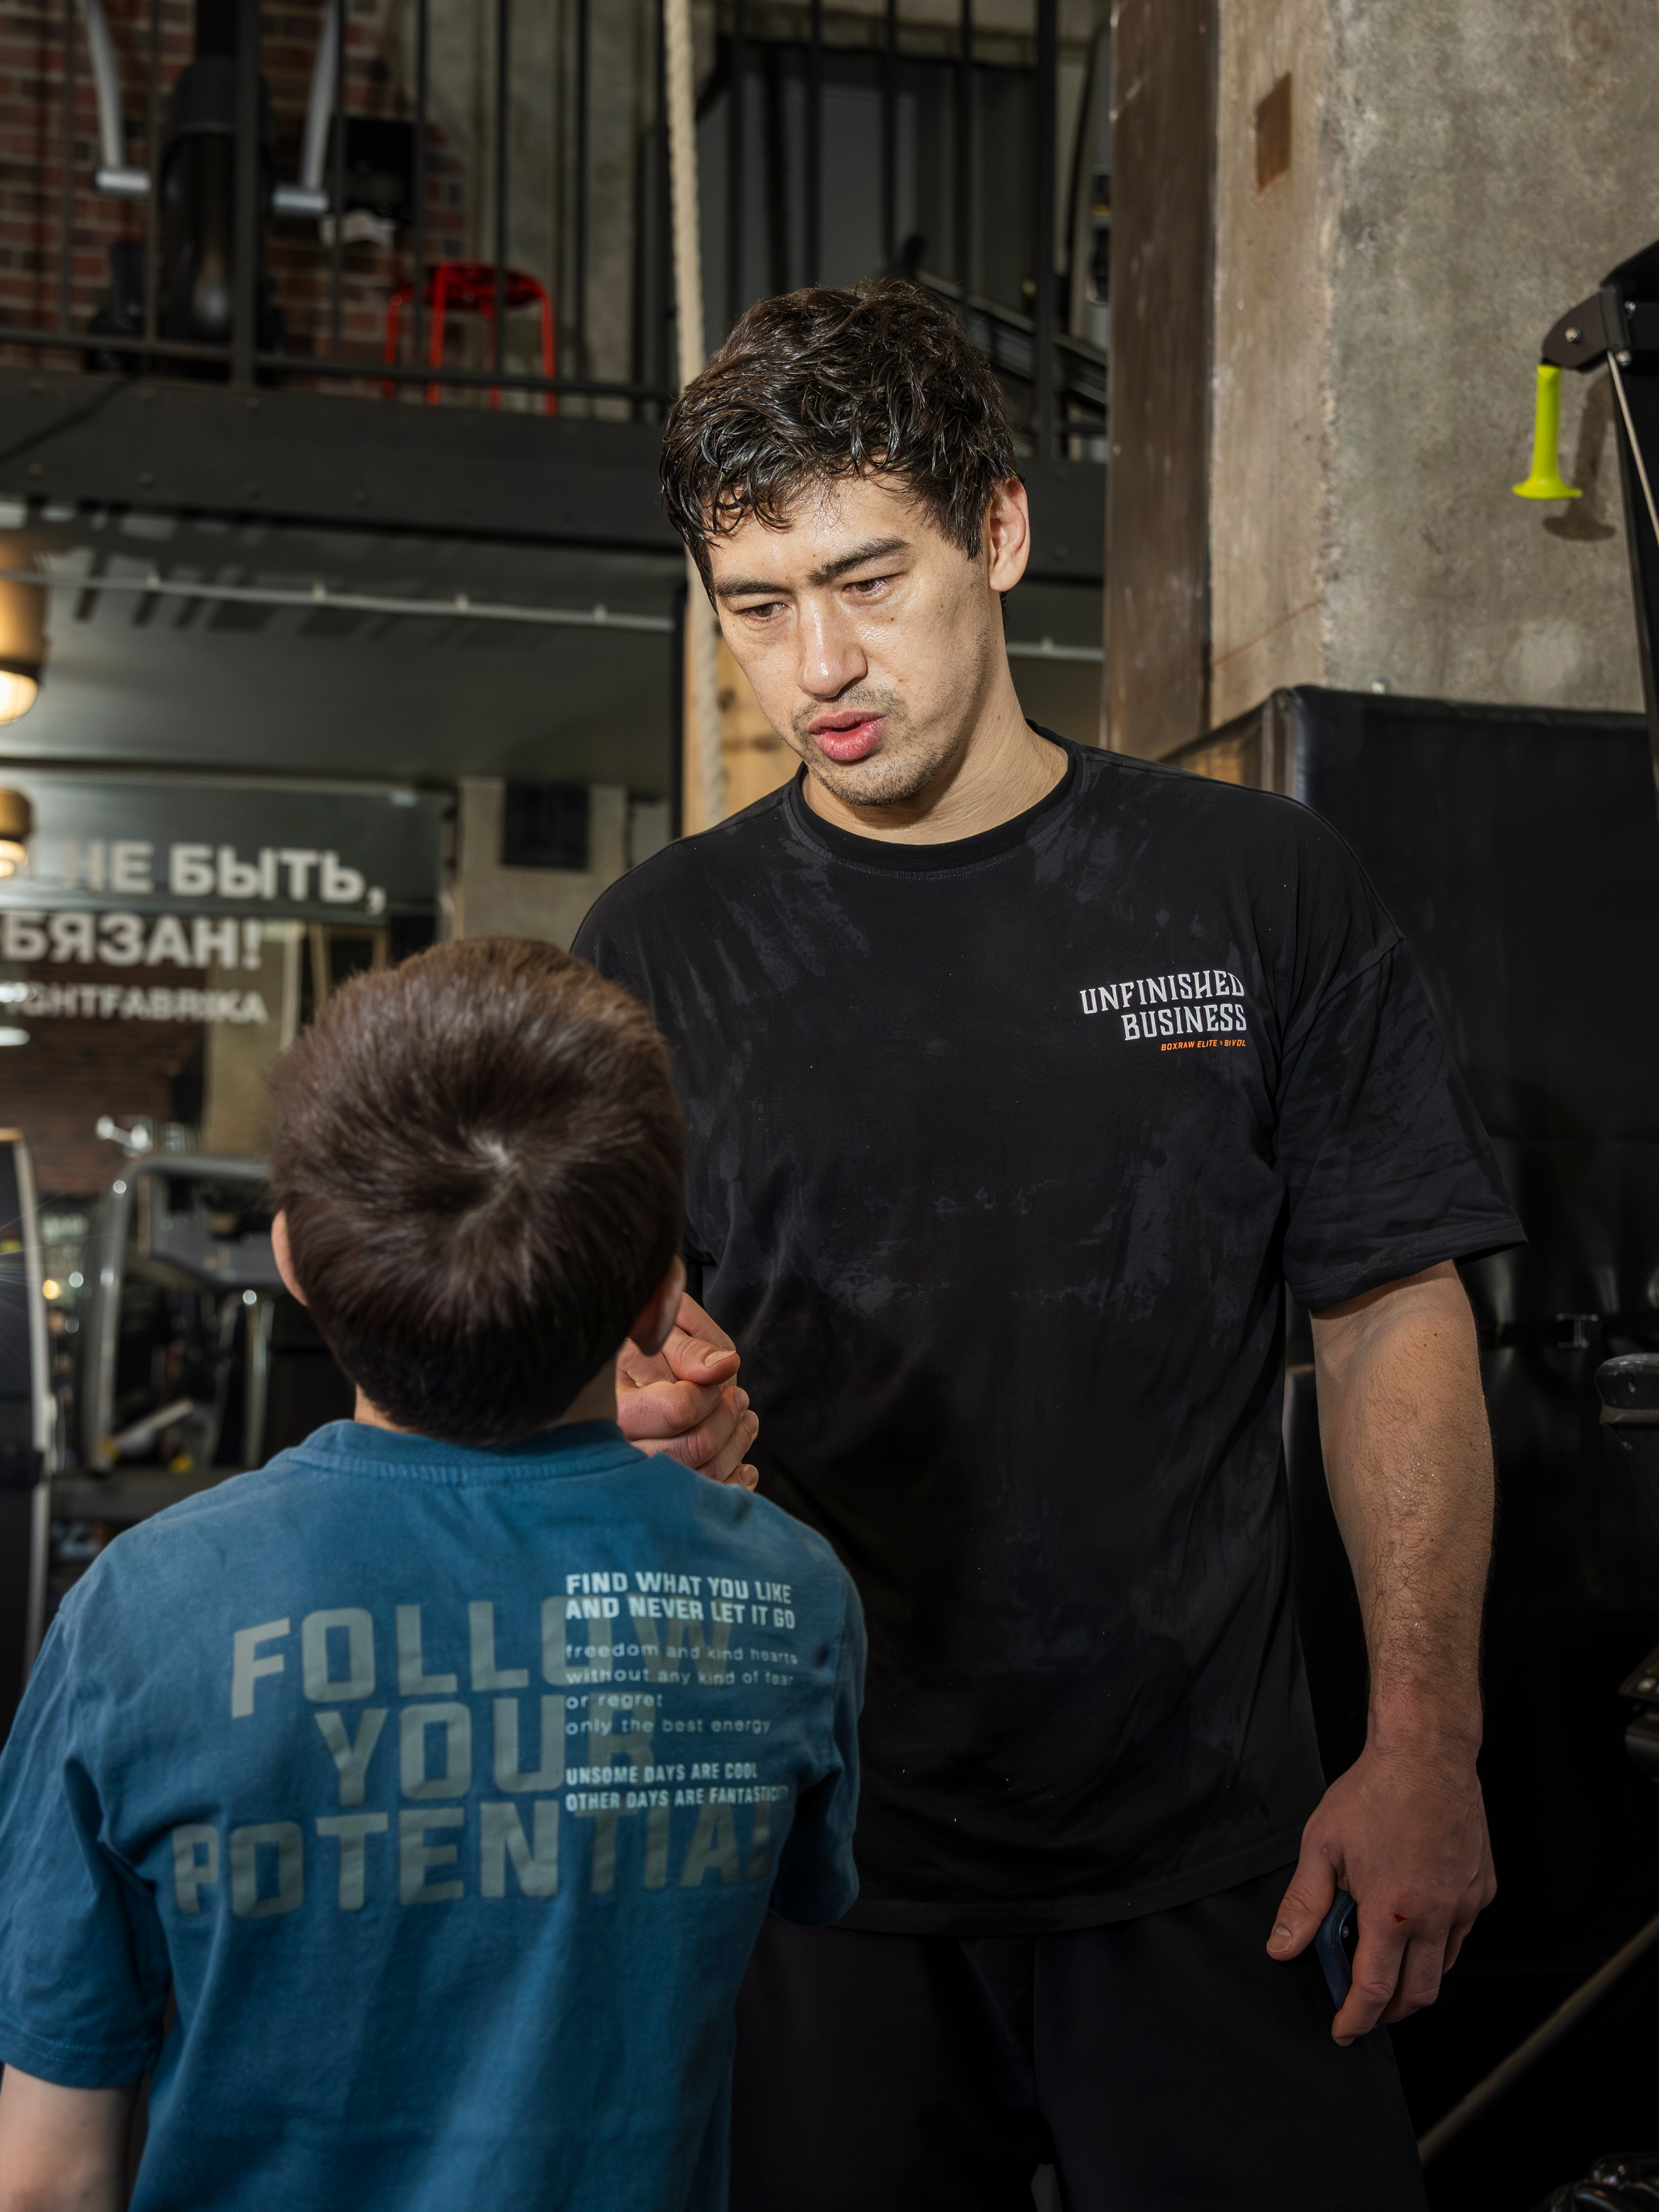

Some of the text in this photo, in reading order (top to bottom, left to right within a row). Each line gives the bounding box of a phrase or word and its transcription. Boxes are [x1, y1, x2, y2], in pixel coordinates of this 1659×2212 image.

[62, 841, 156, 894] НЕ
[168, 843, 387, 915] БЫТЬ,
[1, 911, 263, 970] БЯЗАН!
[1079, 970, 1245, 1014] UNFINISHED
[1120, 1003, 1247, 1041] BUSINESS
[1161, 1041, 1195, 1051] BOXRAW
[1197, 1040, 1218, 1048] ELITE
[566, 1572, 792, 1604] FIND WHAT YOU LIKE
[566, 1597, 796, 1629] AND NEVER LET IT GO
[231, 1592, 734, 1718] FOLLOW
[566, 1642, 798, 1665] freedom and kind hearts
[566, 1667, 795, 1686] without any kind of fear
[566, 1693, 663, 1710] or regret
[566, 1718, 771, 1736] only the best energy
[314, 1691, 656, 1806] YOUR
[644, 1764, 686, 1784] DAYS
[690, 1762, 720, 1780] ARE
[725, 1762, 758, 1780] COOL
[566, 1791, 620, 1812] OTHER
[625, 1789, 669, 1810] DAYS
[674, 1787, 704, 1807] ARE
